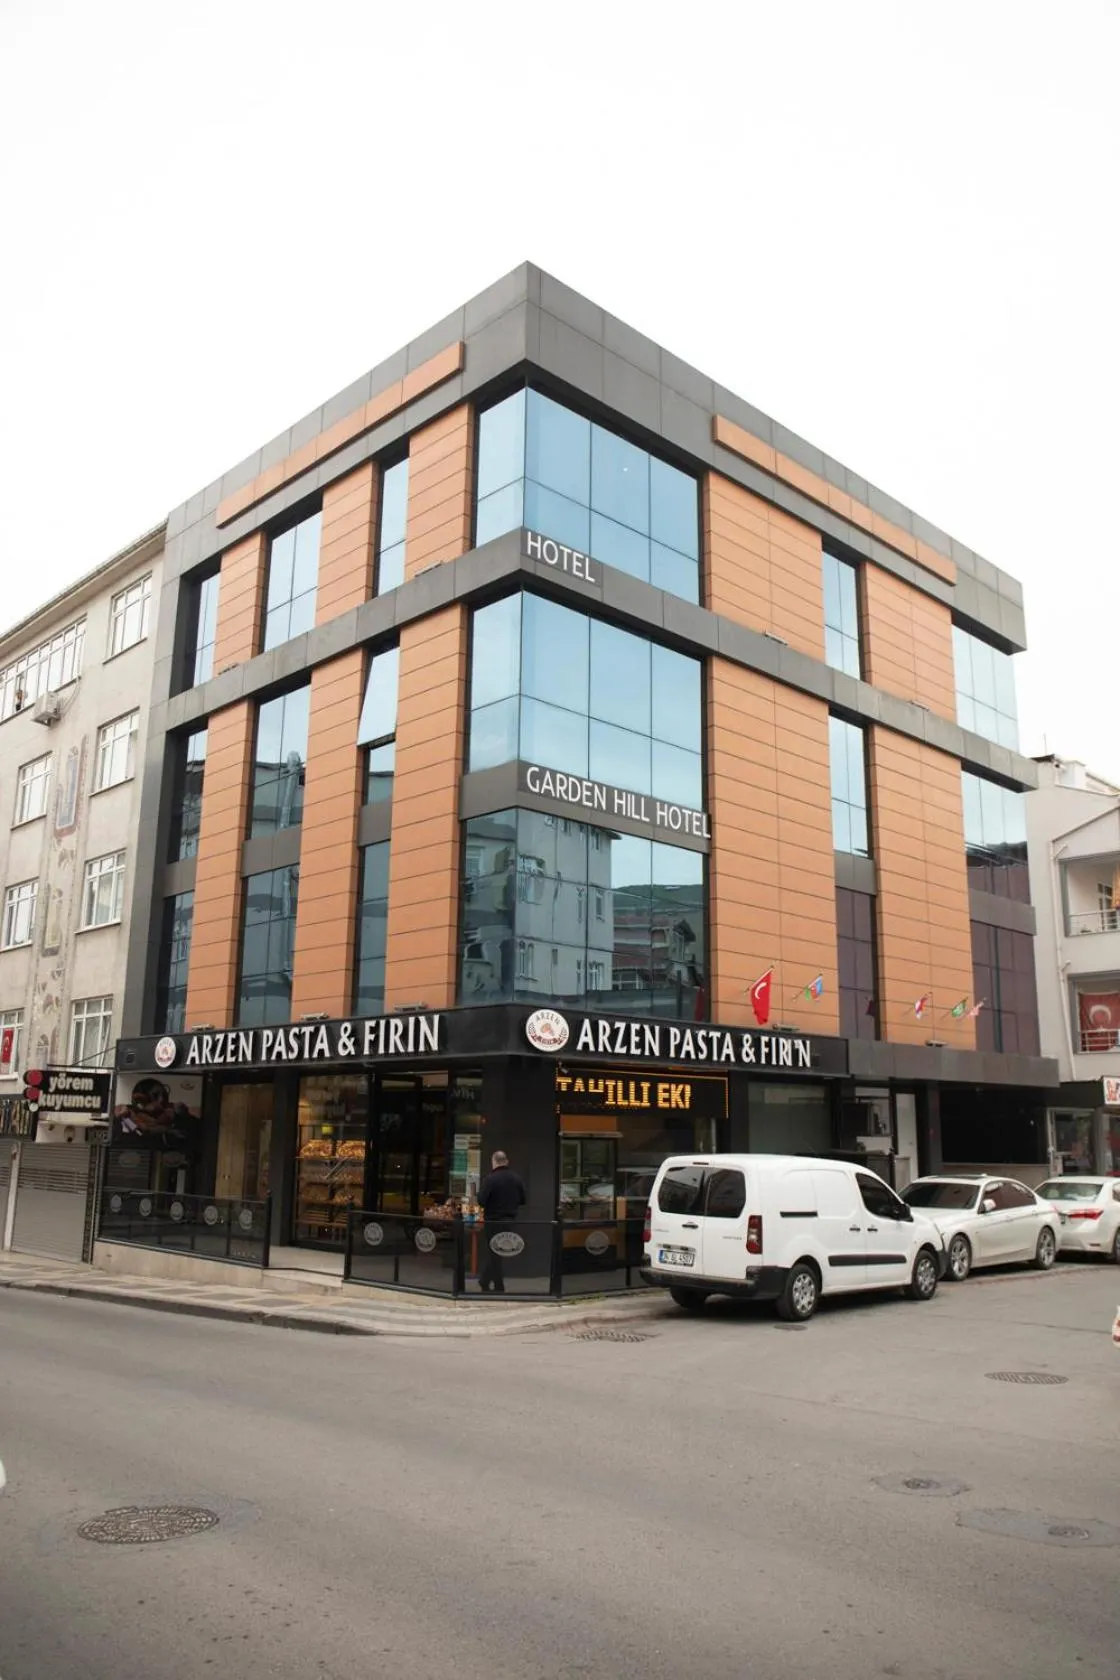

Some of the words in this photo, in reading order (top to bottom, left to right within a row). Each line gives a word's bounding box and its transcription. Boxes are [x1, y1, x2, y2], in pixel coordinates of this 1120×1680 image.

[526, 531, 596, 583] HOTEL
[526, 766, 607, 811] GARDEN
[613, 789, 651, 823] HILL
[655, 801, 711, 838] HOTEL
[185, 1029, 254, 1065] ARZEN
[261, 1025, 331, 1061] PASTA
[337, 1021, 356, 1057] &
[363, 1014, 440, 1055] FIRIN
[576, 1018, 660, 1057] ARZEN
[669, 1026, 736, 1063] PASTA
[741, 1033, 756, 1063] &
[38, 1089, 101, 1111] kuyumcu
[48, 1072, 94, 1093] yörem
